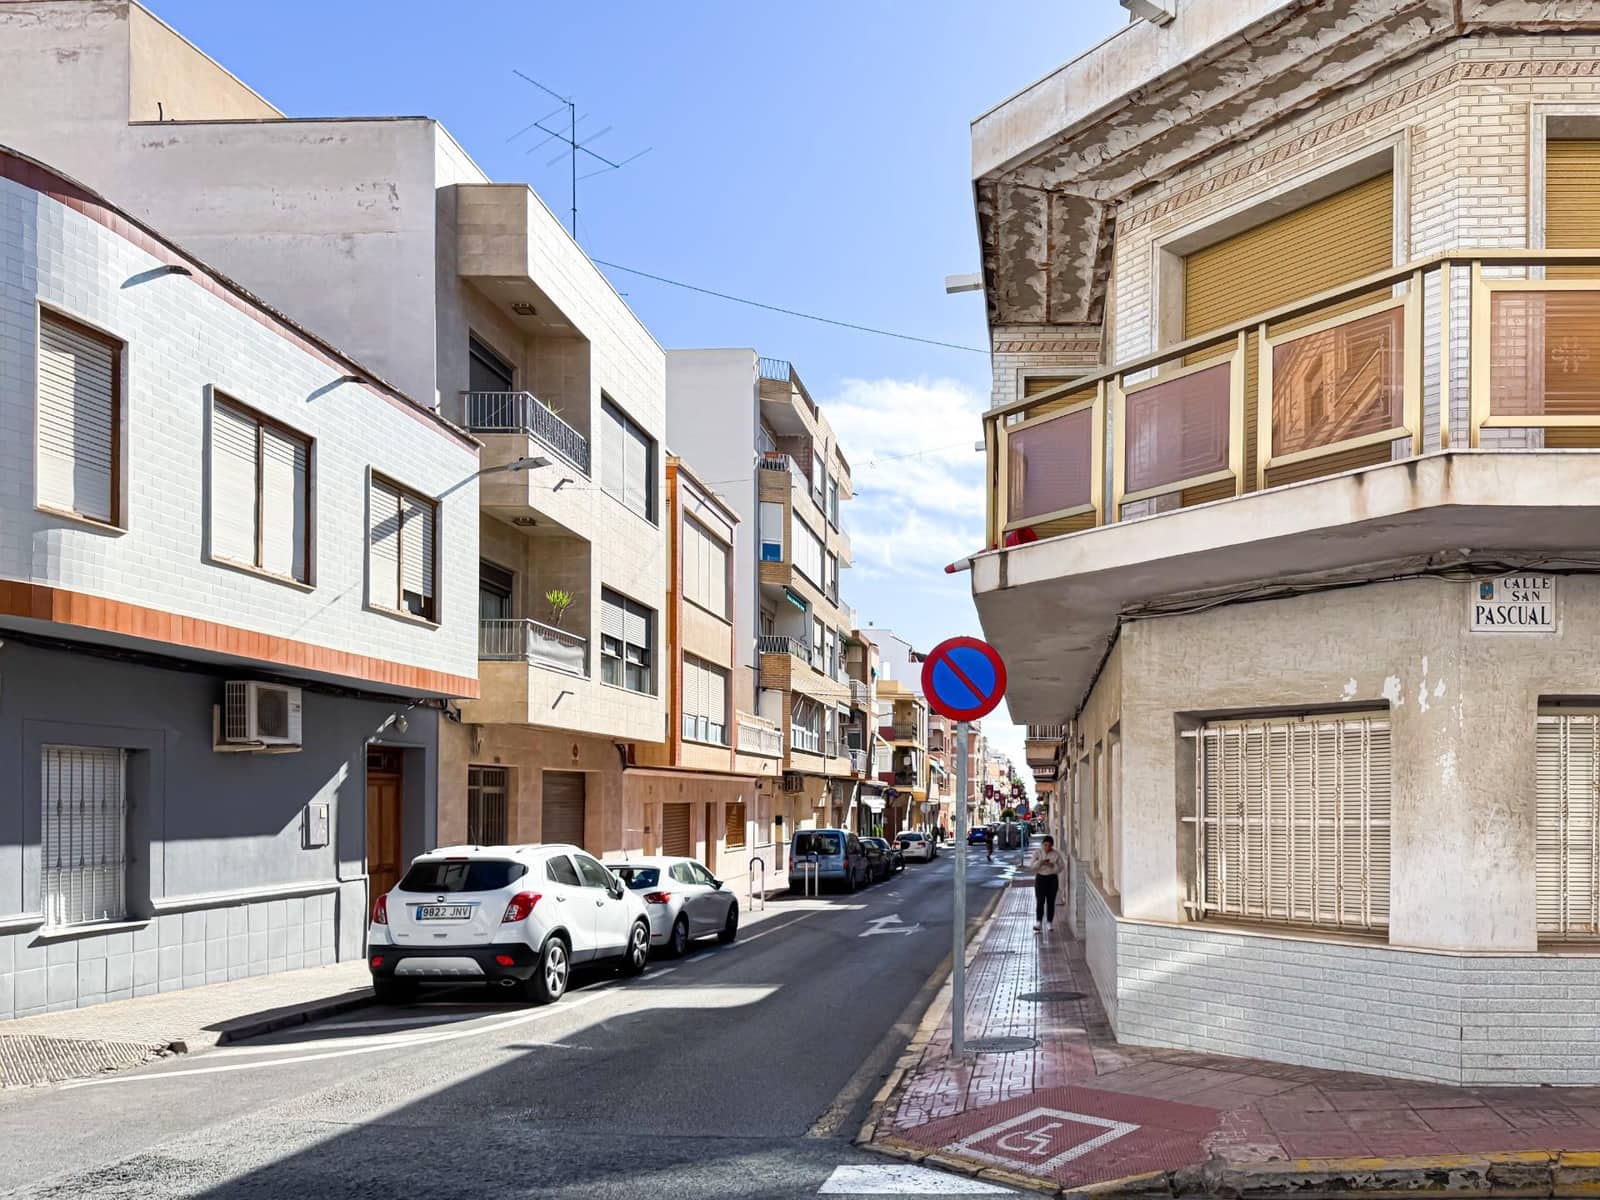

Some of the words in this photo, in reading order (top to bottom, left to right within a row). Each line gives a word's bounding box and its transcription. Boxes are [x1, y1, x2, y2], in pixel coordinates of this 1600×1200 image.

[1503, 577, 1551, 589] CALLE
[1511, 591, 1541, 602] SAN
[1475, 605, 1551, 625] PASCUAL
[449, 906, 469, 917] JNV
